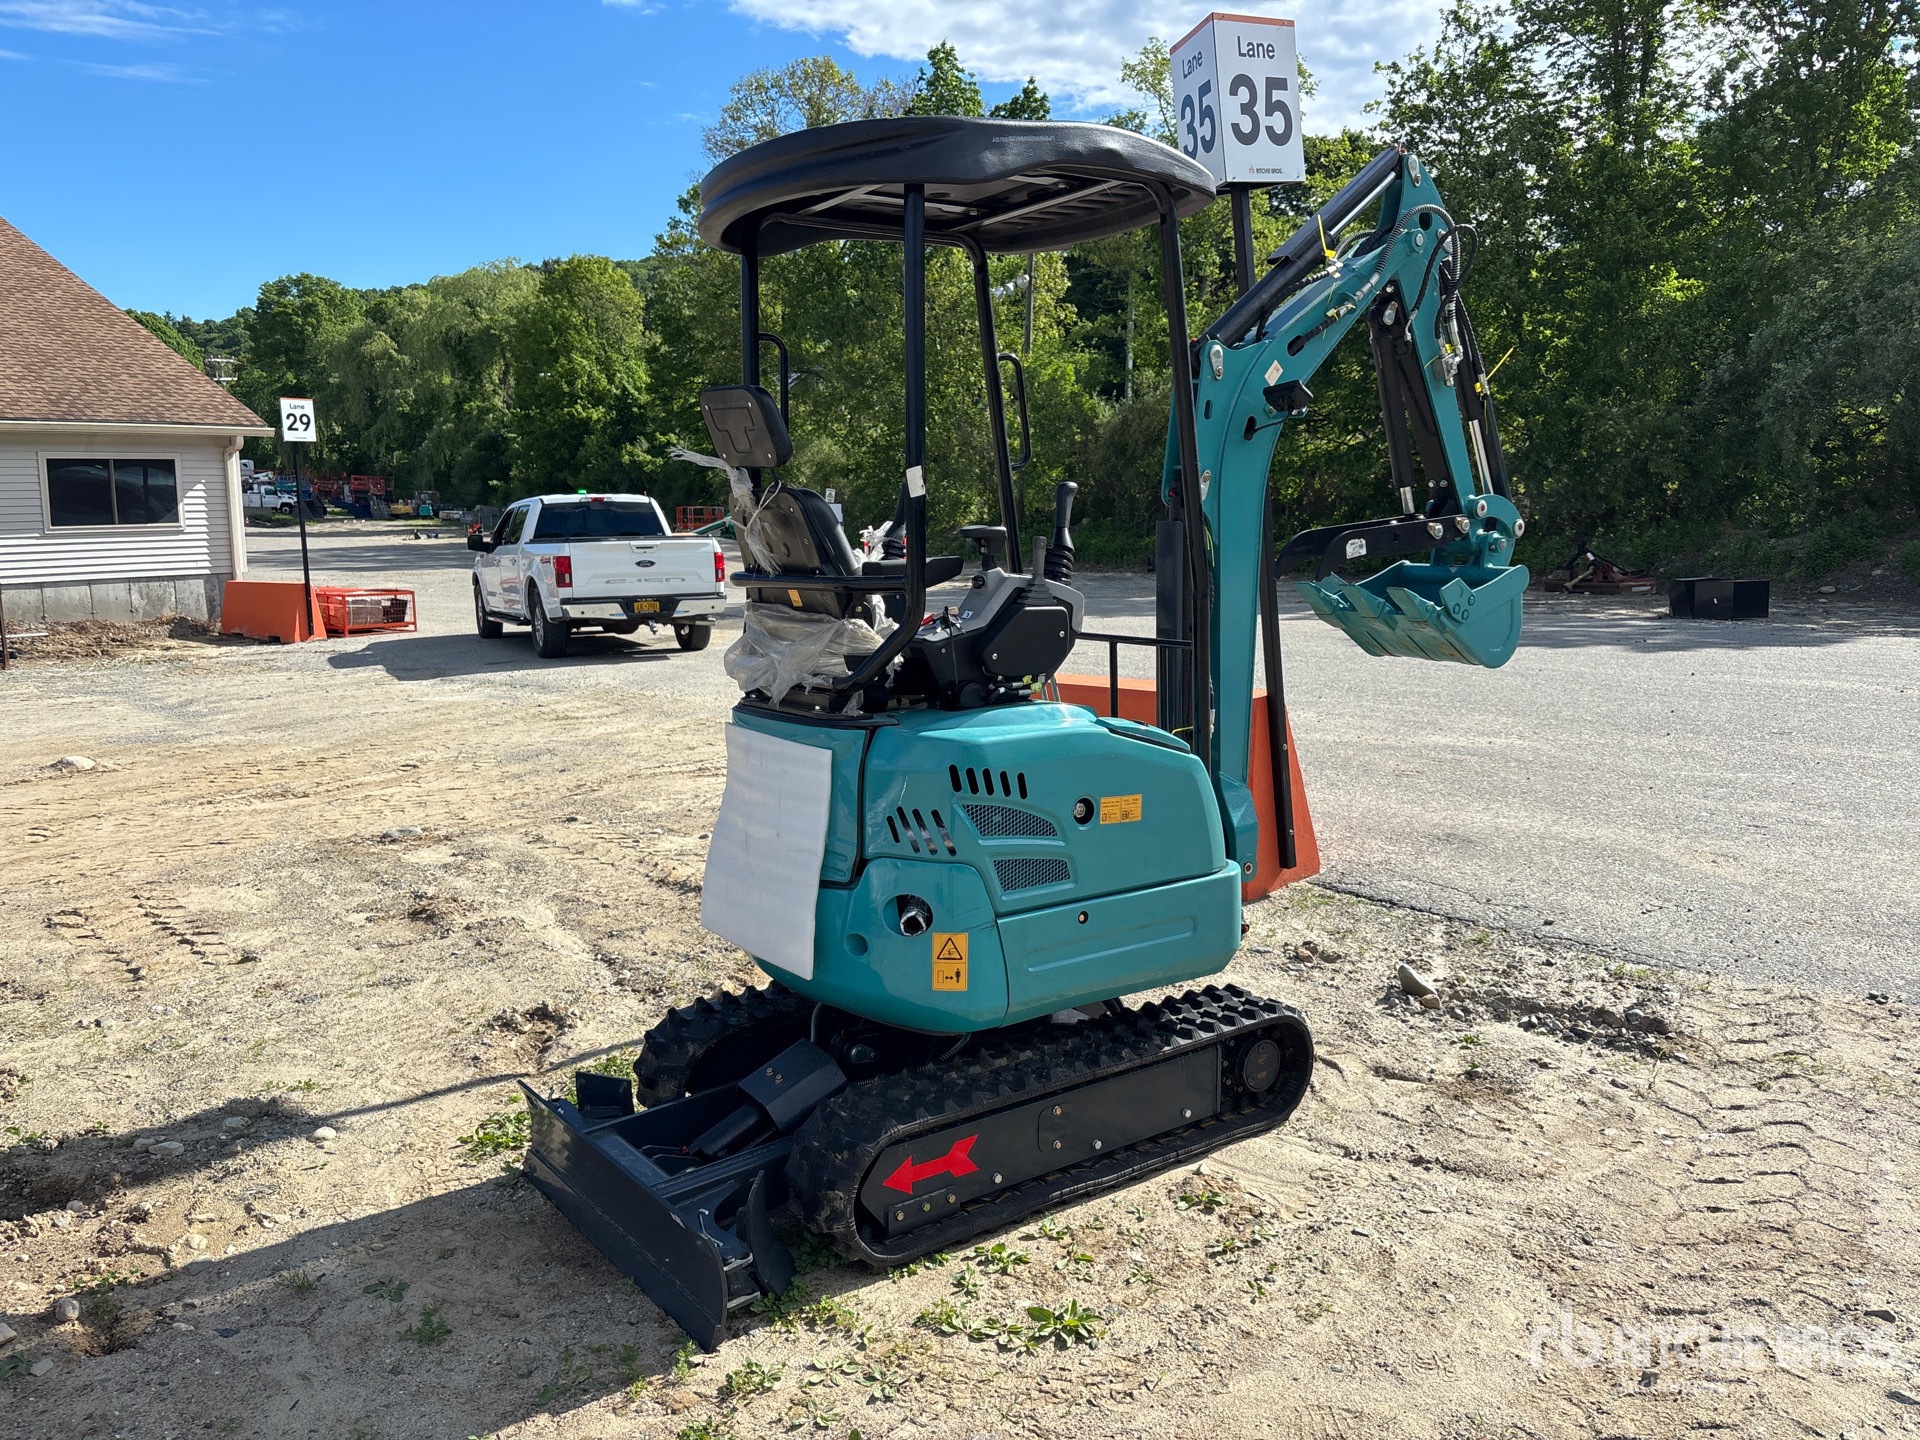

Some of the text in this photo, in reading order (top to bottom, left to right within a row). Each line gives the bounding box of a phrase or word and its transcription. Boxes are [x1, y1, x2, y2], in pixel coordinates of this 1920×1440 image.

[1237, 35, 1275, 60] Lane
[1182, 50, 1203, 80] Lane
[1180, 79, 1216, 160] 35
[1229, 73, 1293, 147] 35
[286, 413, 311, 432] 29
